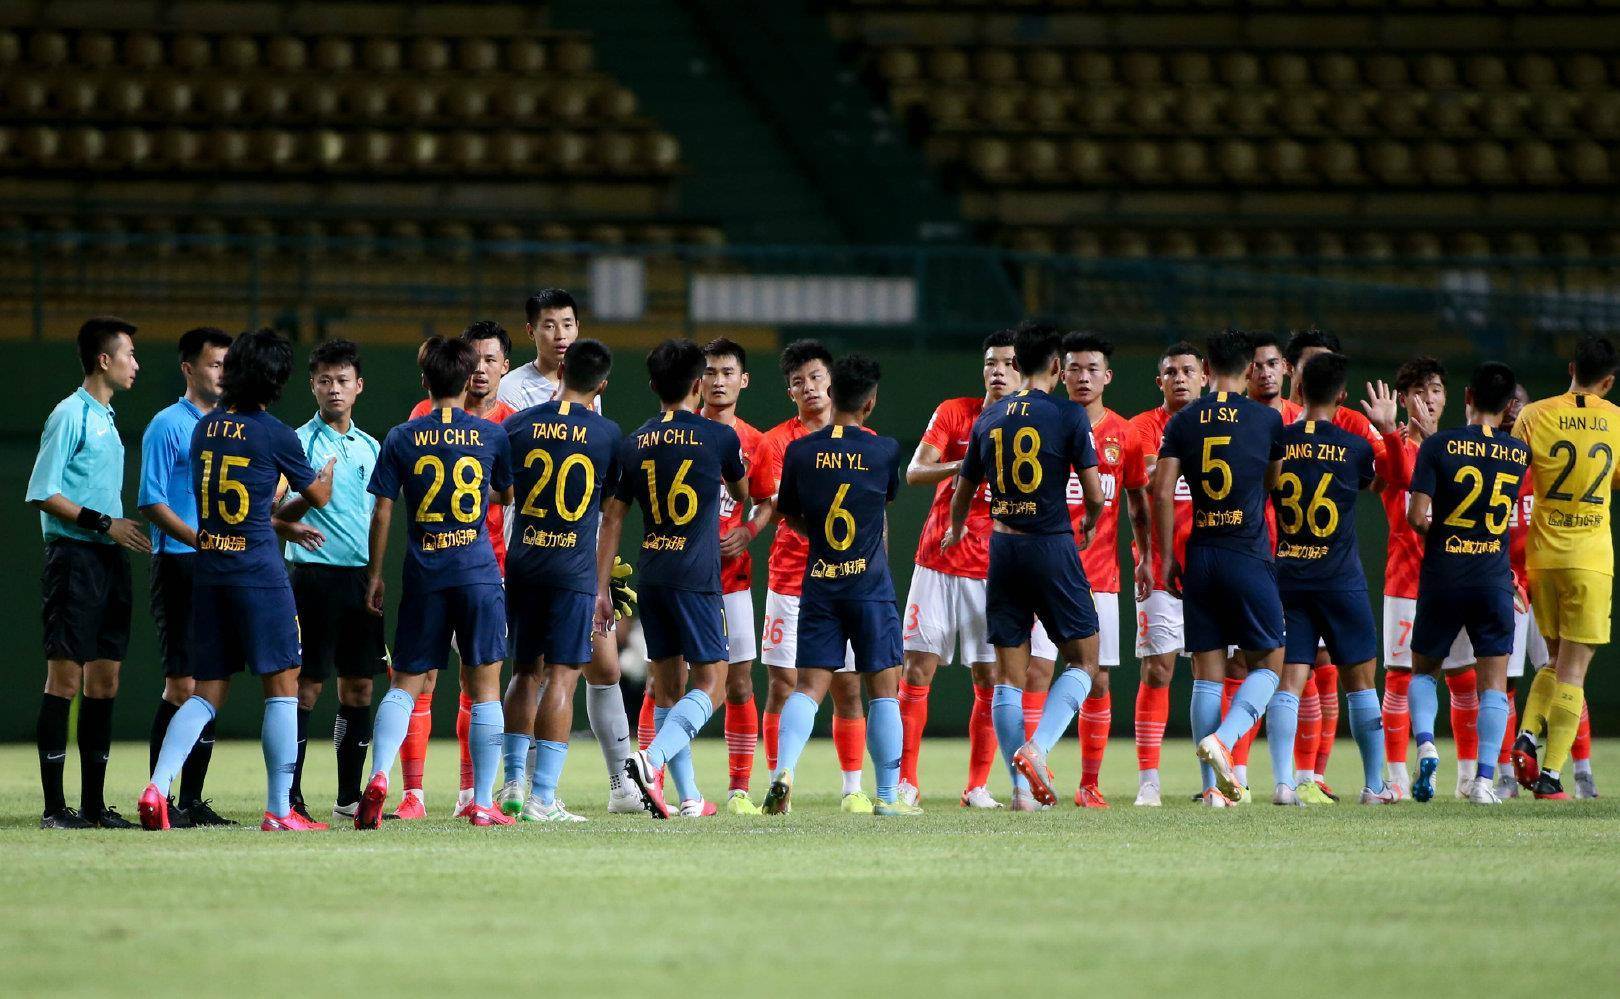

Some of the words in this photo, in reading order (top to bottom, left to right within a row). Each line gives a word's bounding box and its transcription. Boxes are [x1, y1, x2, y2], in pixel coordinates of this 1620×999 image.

[1007, 402, 1017, 415] YI
[1022, 402, 1030, 415] T.
[1200, 409, 1211, 423] LI
[1218, 407, 1238, 422] S.Y.
[207, 421, 218, 437] LI
[223, 421, 245, 439] T.X.
[533, 423, 567, 440] TANG
[573, 426, 586, 444] M.
[1559, 416, 1586, 431] HAN
[415, 430, 439, 446] WU
[444, 429, 483, 446] CH.R.
[638, 431, 659, 448] TAN
[664, 429, 702, 445] CH.L.
[1447, 440, 1487, 458] CHEN
[816, 453, 842, 468] FAN
[847, 453, 868, 470] Y.L.
[989, 427, 1043, 494] 18
[1318, 444, 1346, 461] ZH.Y.
[1202, 436, 1232, 500] 5
[1545, 440, 1613, 505] 22
[200, 451, 250, 524] 15
[414, 455, 483, 523] 28
[521, 449, 594, 521] 20
[641, 460, 698, 525] 16
[1278, 470, 1338, 537] 36
[1444, 466, 1519, 535] 25
[825, 483, 855, 550] 6
[762, 615, 784, 645] 36
[1397, 622, 1413, 646] 7
